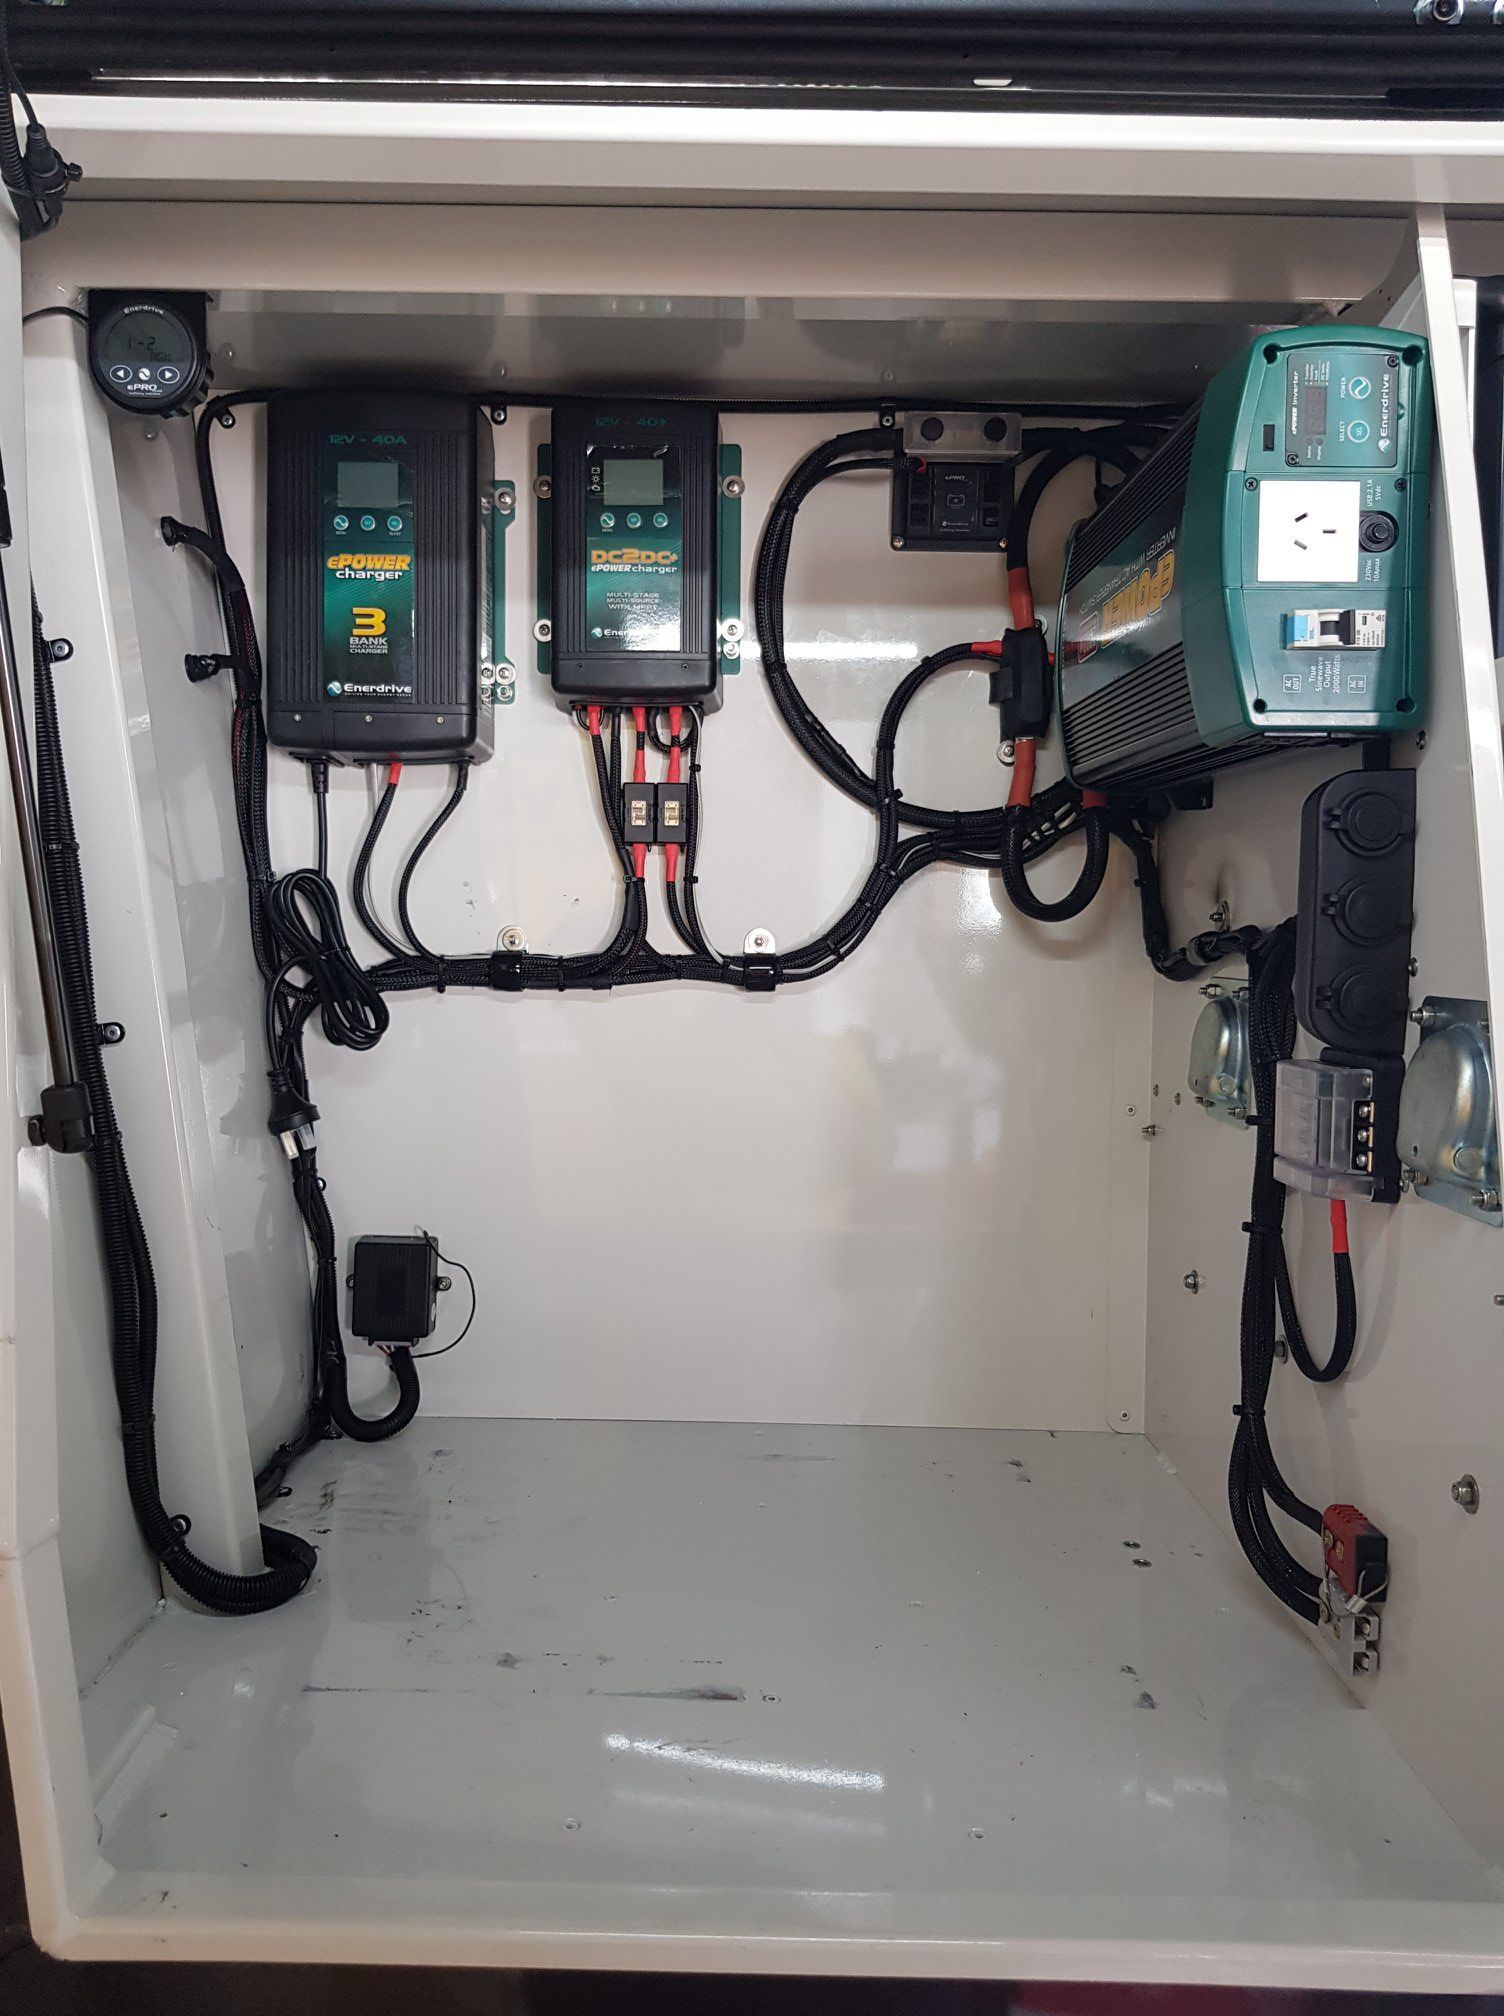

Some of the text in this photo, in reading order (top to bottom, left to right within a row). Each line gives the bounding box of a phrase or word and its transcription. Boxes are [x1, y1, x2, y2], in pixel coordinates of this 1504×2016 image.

[124, 305, 164, 314] Enerdrive
[1380, 374, 1389, 437] Enerdrive
[330, 434, 354, 444] 12V
[372, 435, 407, 445] 40A
[326, 554, 412, 570] ePOWER
[335, 567, 403, 581] charger
[591, 564, 678, 575] ePOWER charger
[352, 607, 388, 636] 3
[350, 637, 389, 646] BANK
[1324, 660, 1332, 688] Output
[344, 683, 412, 694] Enerdrive
[1286, 680, 1292, 688] AC
[1350, 680, 1356, 688] AC
[1358, 680, 1364, 688] IN
